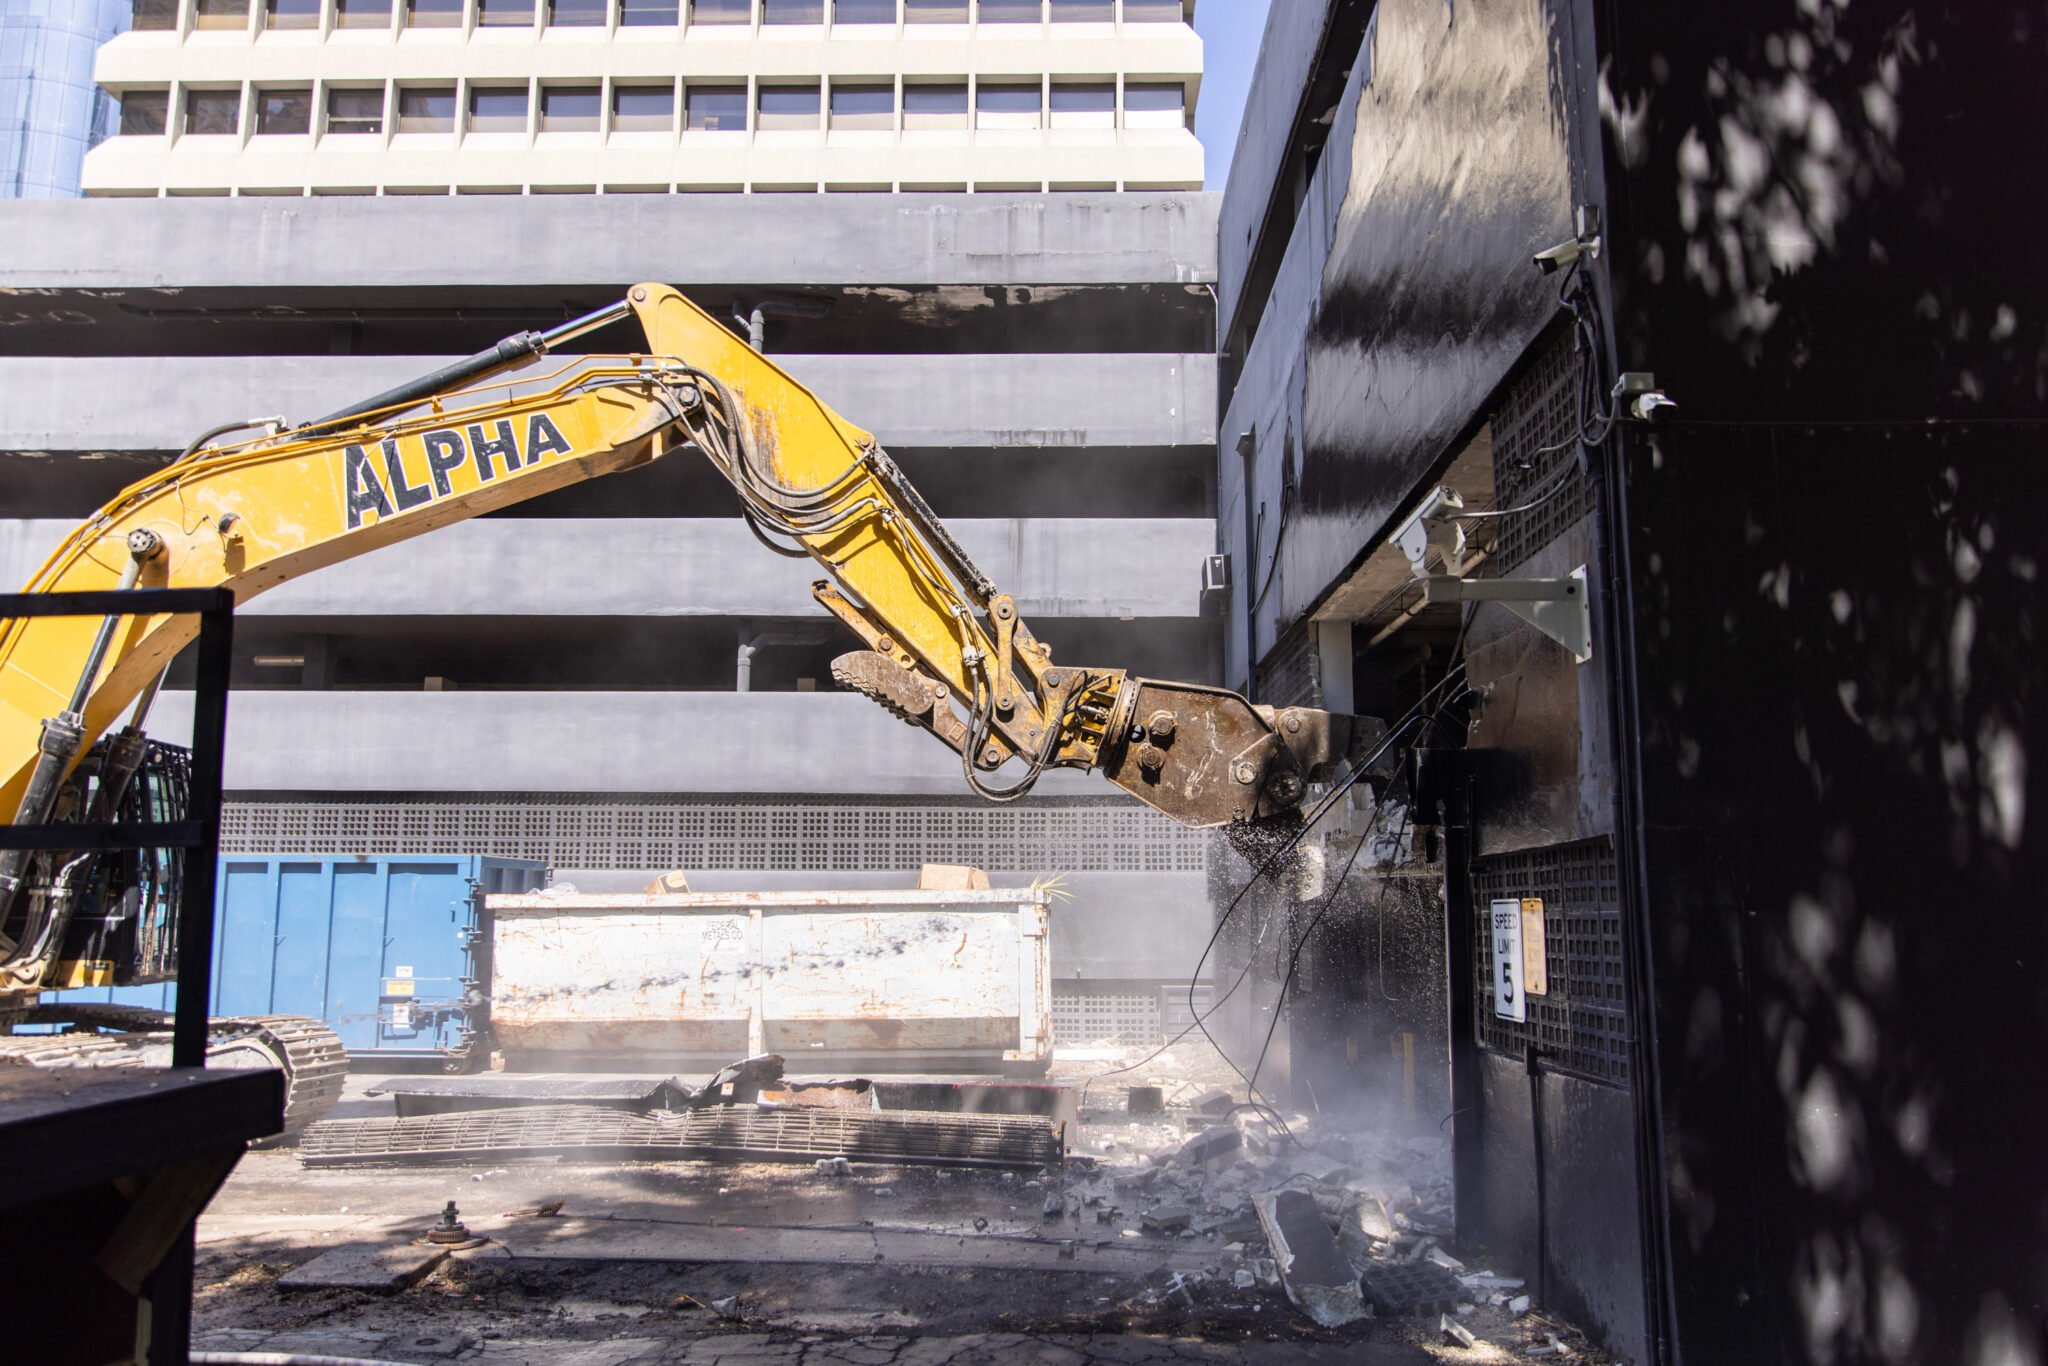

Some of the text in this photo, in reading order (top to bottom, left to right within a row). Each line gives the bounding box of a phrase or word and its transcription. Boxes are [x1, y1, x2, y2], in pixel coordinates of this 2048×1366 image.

[345, 412, 572, 531] ALPHA
[706, 920, 740, 931] FEDERAL
[1494, 912, 1518, 930] SPEED
[702, 930, 730, 941] METALS
[1497, 938, 1516, 955] LIMIT
[1502, 962, 1514, 1005] 5
